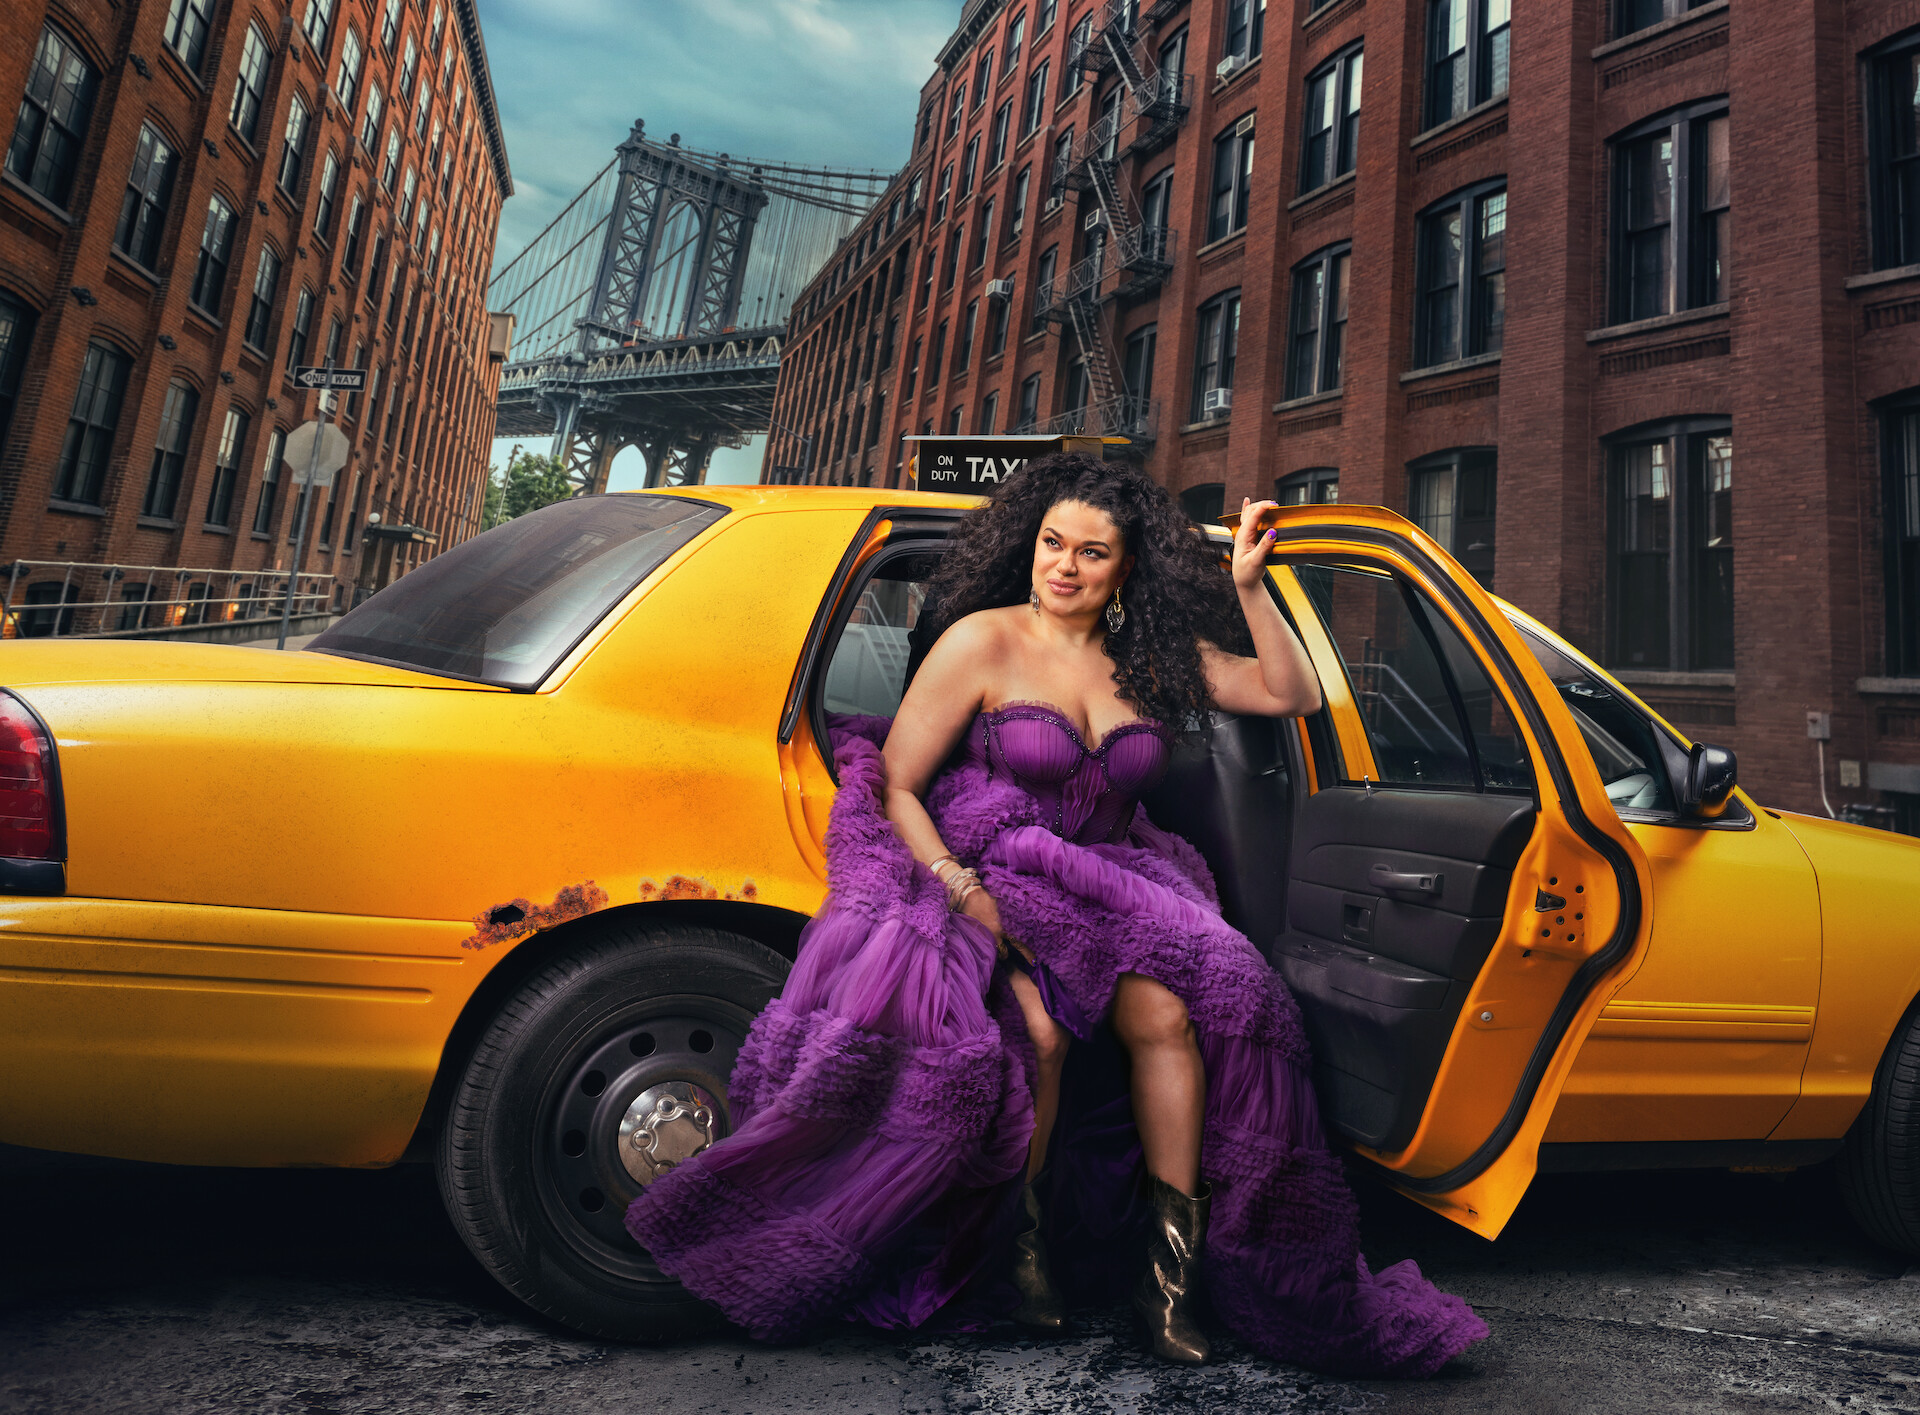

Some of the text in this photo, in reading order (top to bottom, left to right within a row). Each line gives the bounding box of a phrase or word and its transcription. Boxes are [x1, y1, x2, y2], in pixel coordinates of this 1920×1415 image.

[306, 373, 356, 384] ONE WAY
[937, 455, 953, 466] ON
[931, 470, 959, 481] DUTY
